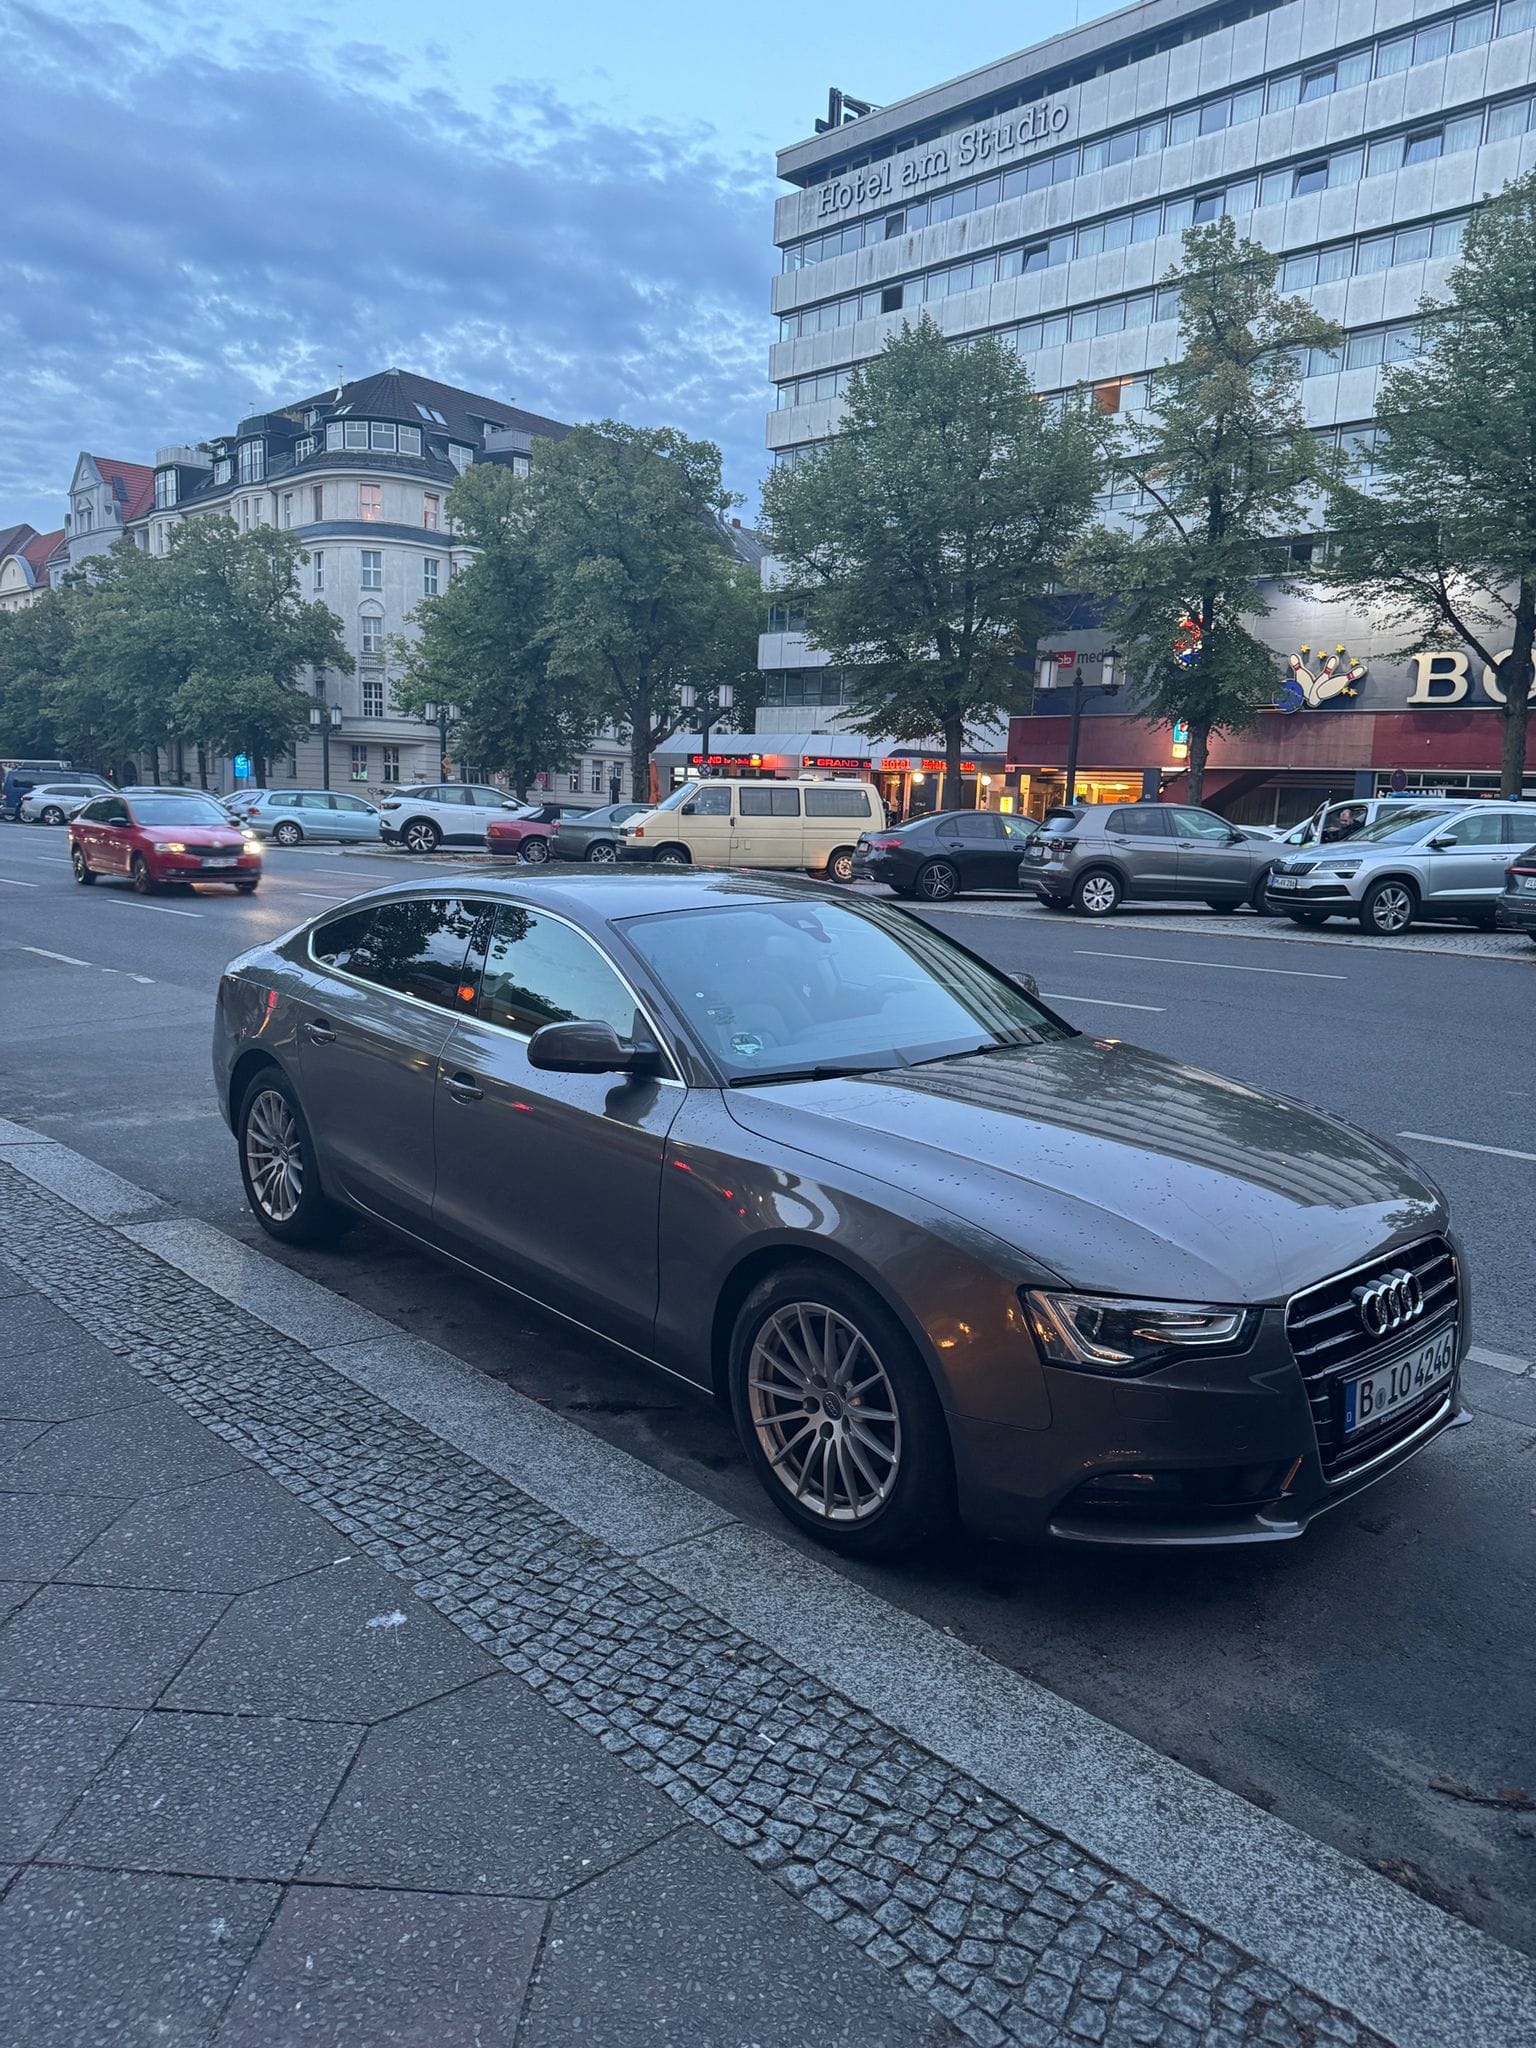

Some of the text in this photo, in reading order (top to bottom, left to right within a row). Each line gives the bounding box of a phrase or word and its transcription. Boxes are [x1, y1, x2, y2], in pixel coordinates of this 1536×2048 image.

[817, 102, 1069, 217] Hotel am Studio
[692, 756, 722, 764] GRND
[817, 758, 859, 768] GRAND
[882, 757, 910, 770] Hotel
[1361, 1380, 1374, 1419] B
[1415, 1334, 1450, 1388] 4246
[1346, 1411, 1352, 1422] D
